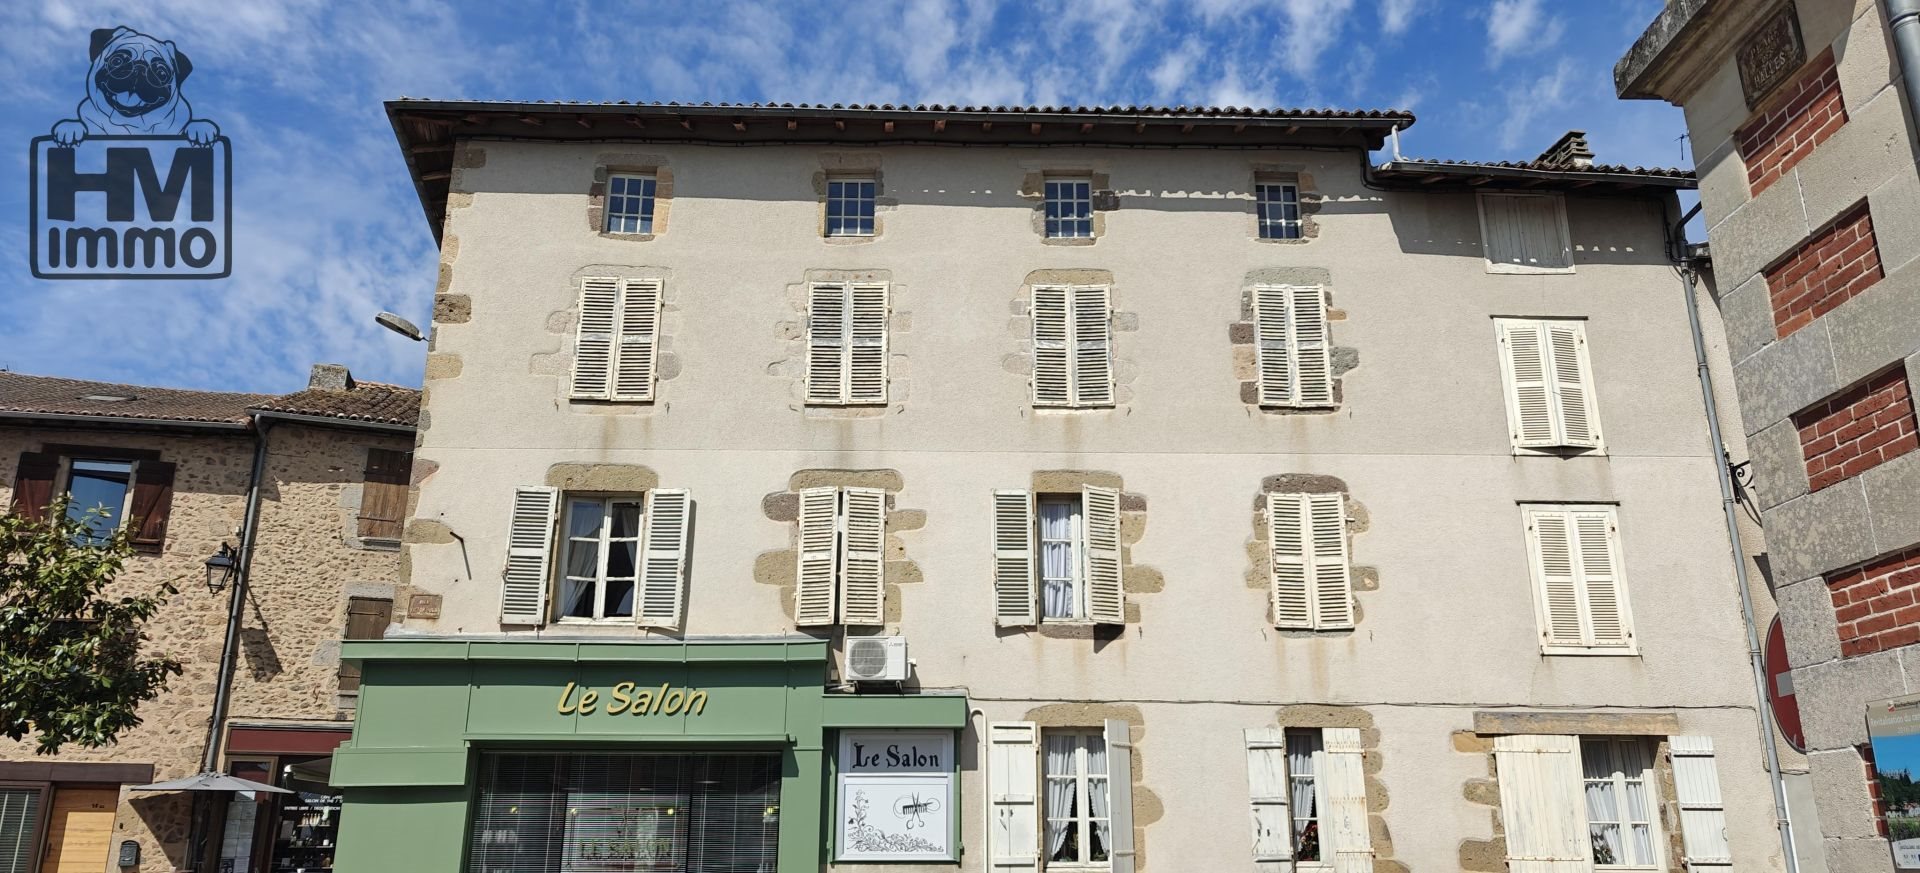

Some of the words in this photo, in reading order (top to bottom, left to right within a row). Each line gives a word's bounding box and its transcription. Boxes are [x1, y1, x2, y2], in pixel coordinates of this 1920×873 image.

[1753, 52, 1786, 88] HALLES
[557, 682, 599, 715] Le
[607, 682, 709, 716] Salon
[852, 742, 880, 769] Le
[886, 744, 939, 769] Salon
